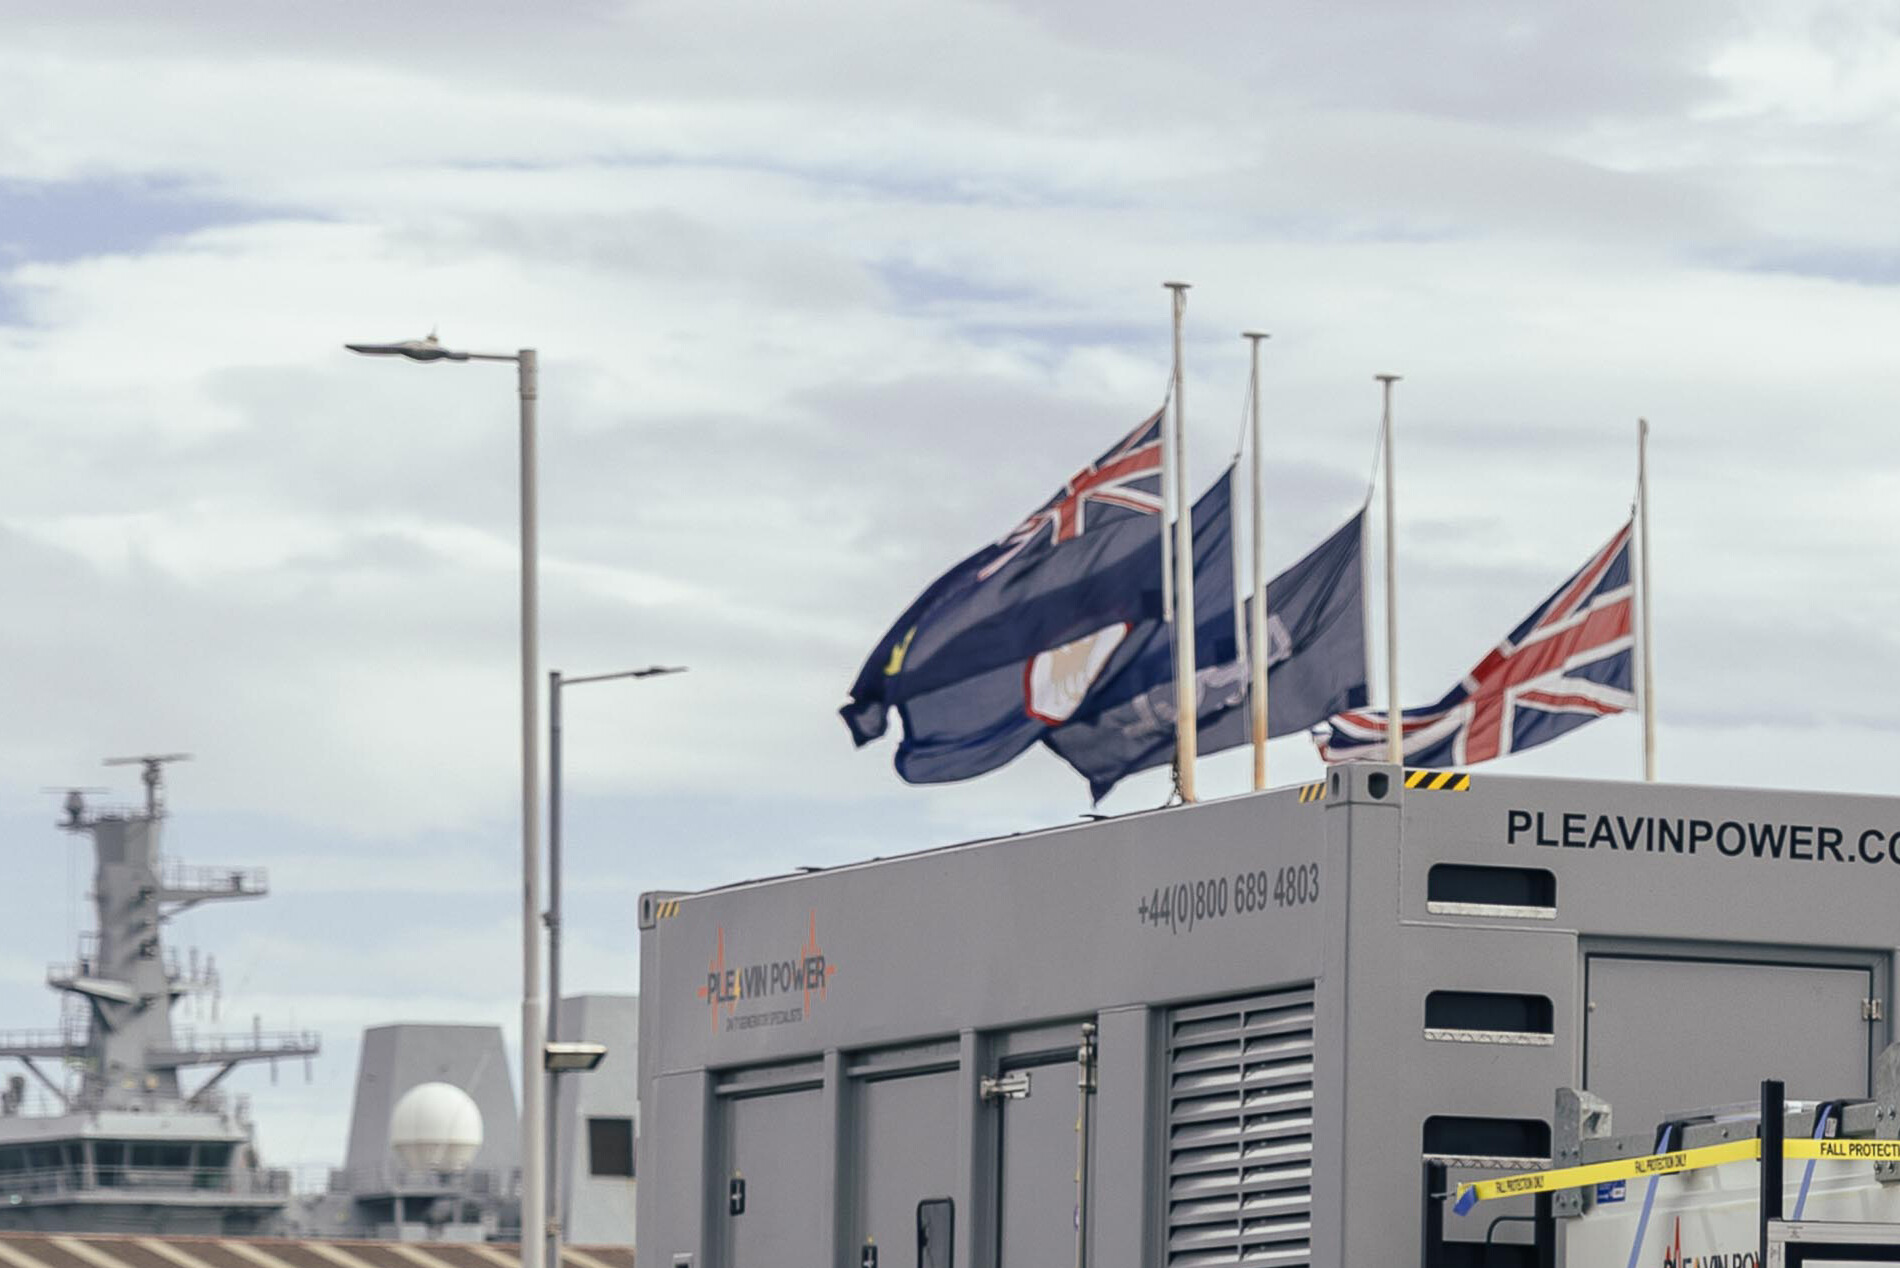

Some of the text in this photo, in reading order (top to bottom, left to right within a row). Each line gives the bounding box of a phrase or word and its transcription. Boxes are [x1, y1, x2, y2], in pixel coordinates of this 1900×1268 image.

[1138, 862, 1319, 935] +44(0)800 689 4803
[707, 956, 826, 1004] PLEAVIN POWER
[1820, 1142, 1847, 1157] FALL
